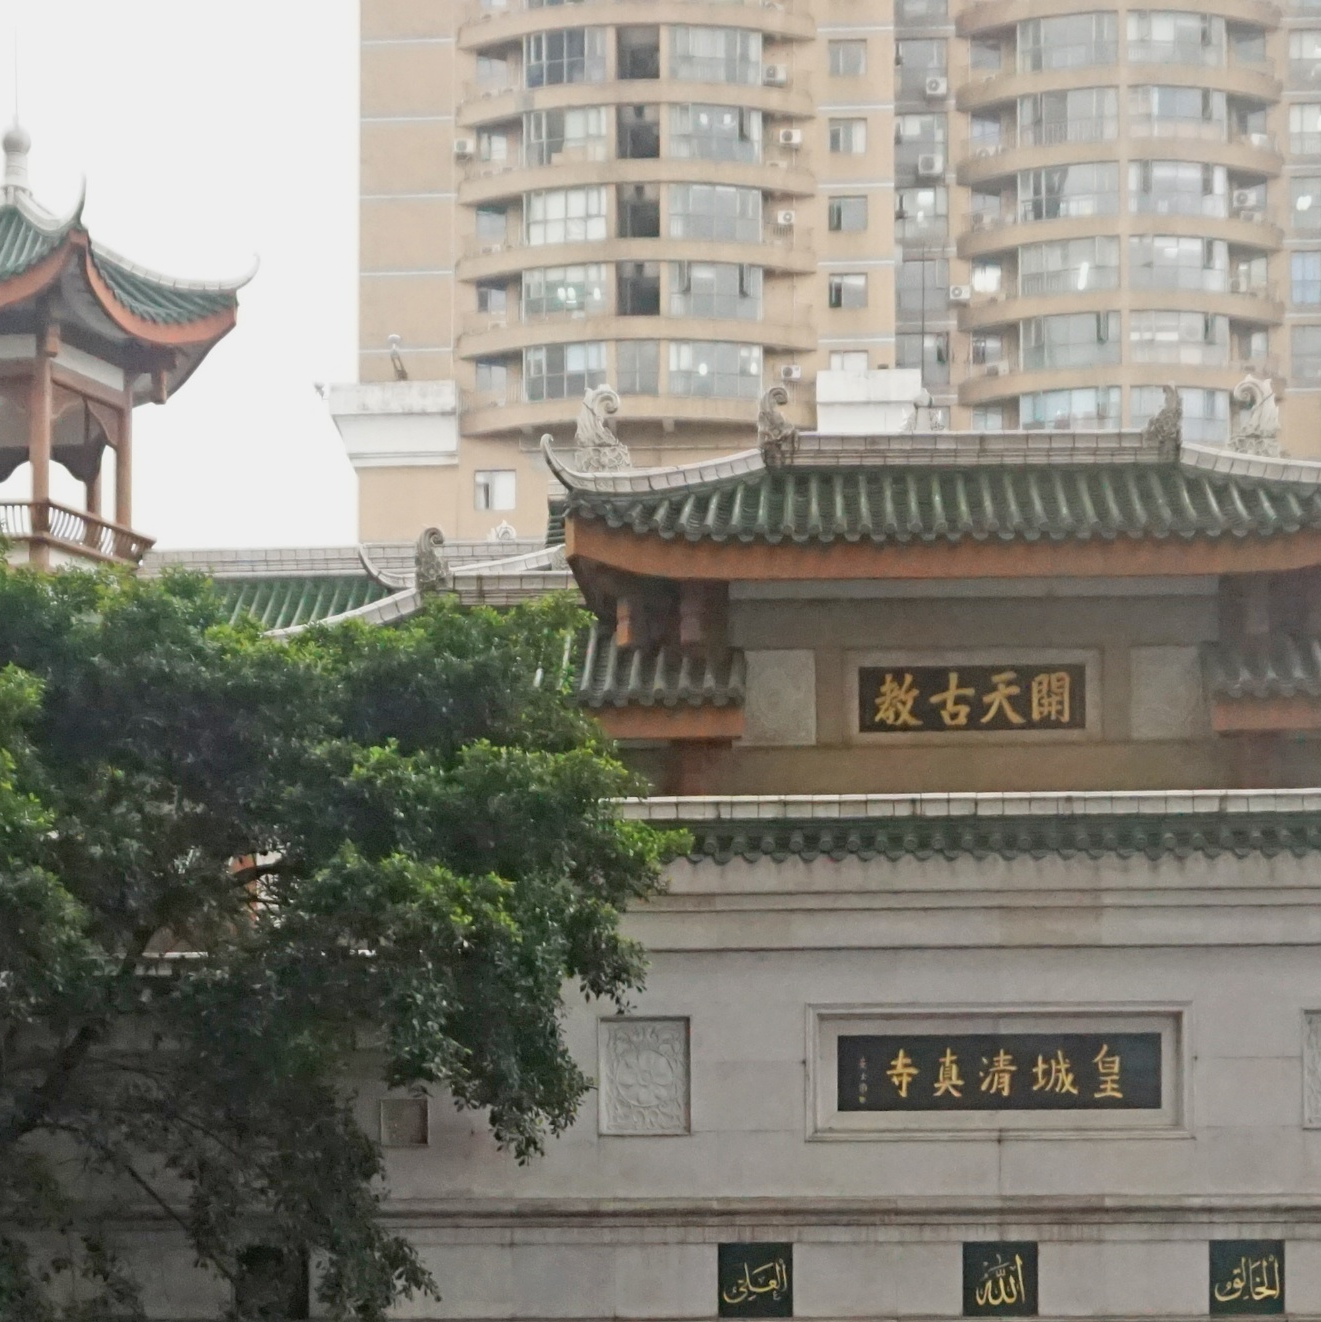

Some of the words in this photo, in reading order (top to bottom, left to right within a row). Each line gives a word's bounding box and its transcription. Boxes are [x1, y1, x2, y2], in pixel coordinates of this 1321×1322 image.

[885, 1043, 1124, 1099] 皇城清真寺
[975, 1253, 1025, 1306] الله
